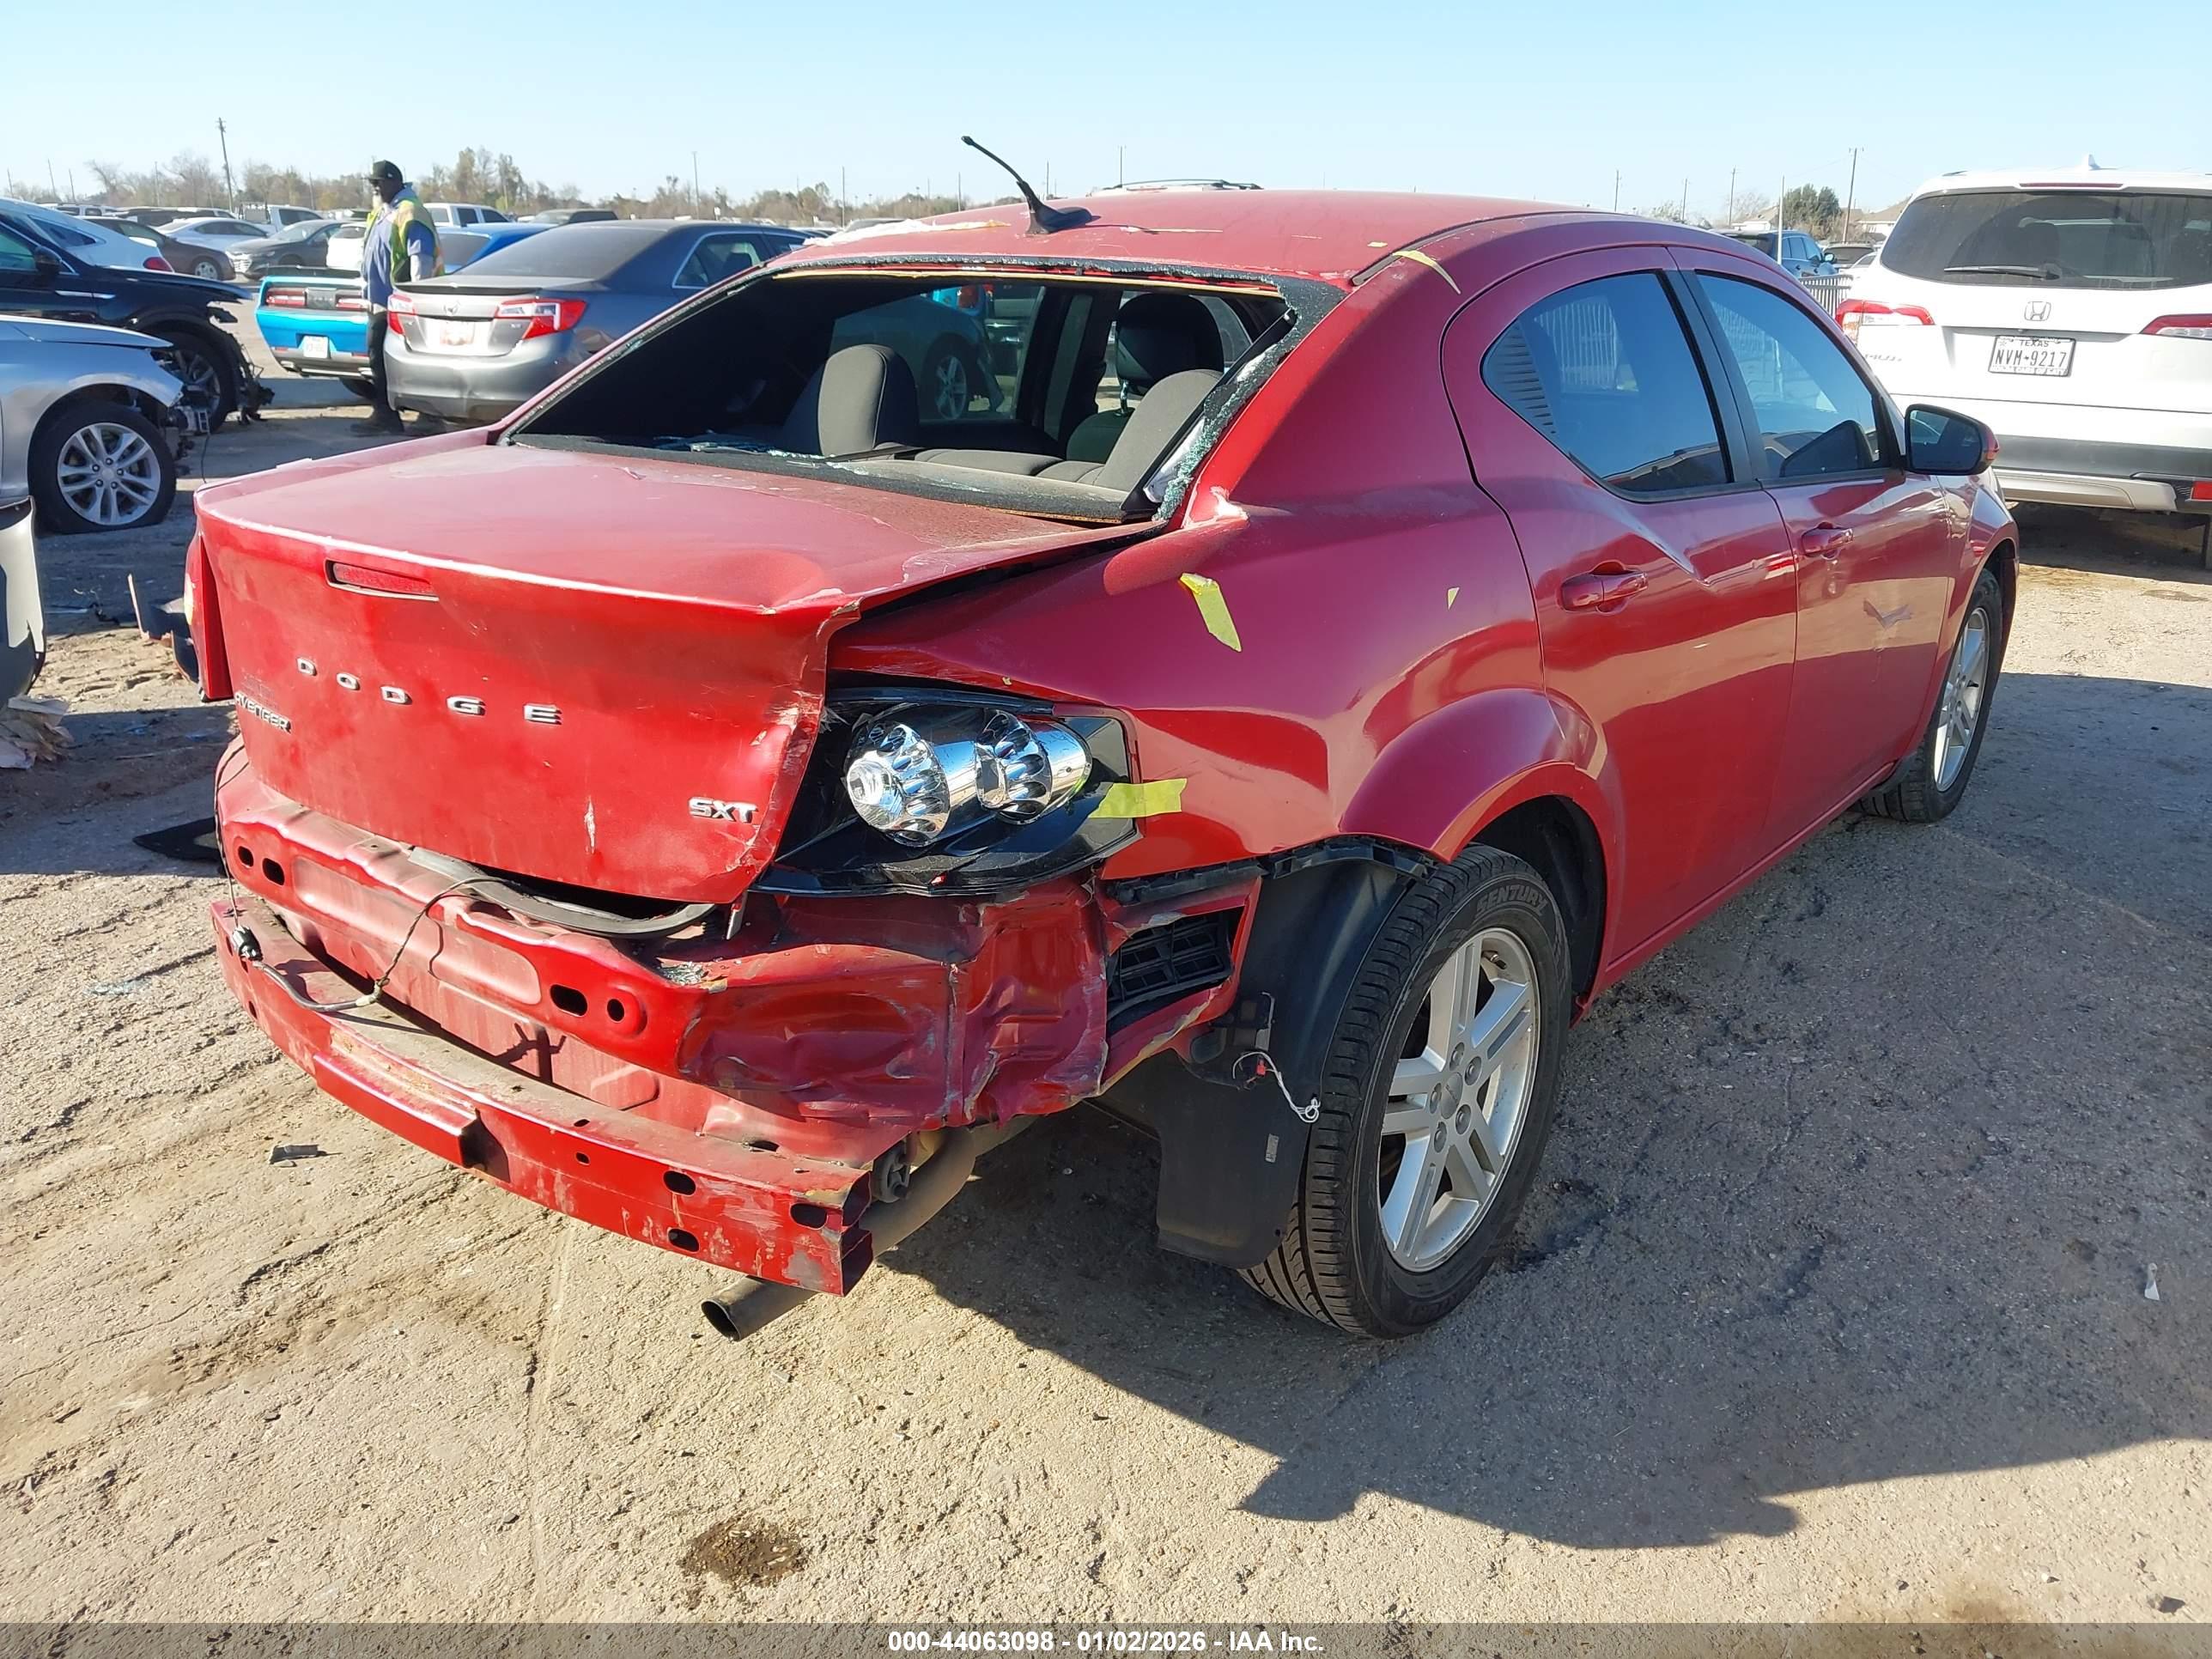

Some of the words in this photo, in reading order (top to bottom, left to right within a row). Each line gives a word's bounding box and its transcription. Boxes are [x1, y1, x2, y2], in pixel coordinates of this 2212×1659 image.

[2019, 339, 2049, 348] TEXAS
[296, 657, 562, 725] DODGE
[234, 691, 291, 735] AVENGER
[688, 796, 759, 823] SXT
[1478, 884, 1548, 916] SENTURY
